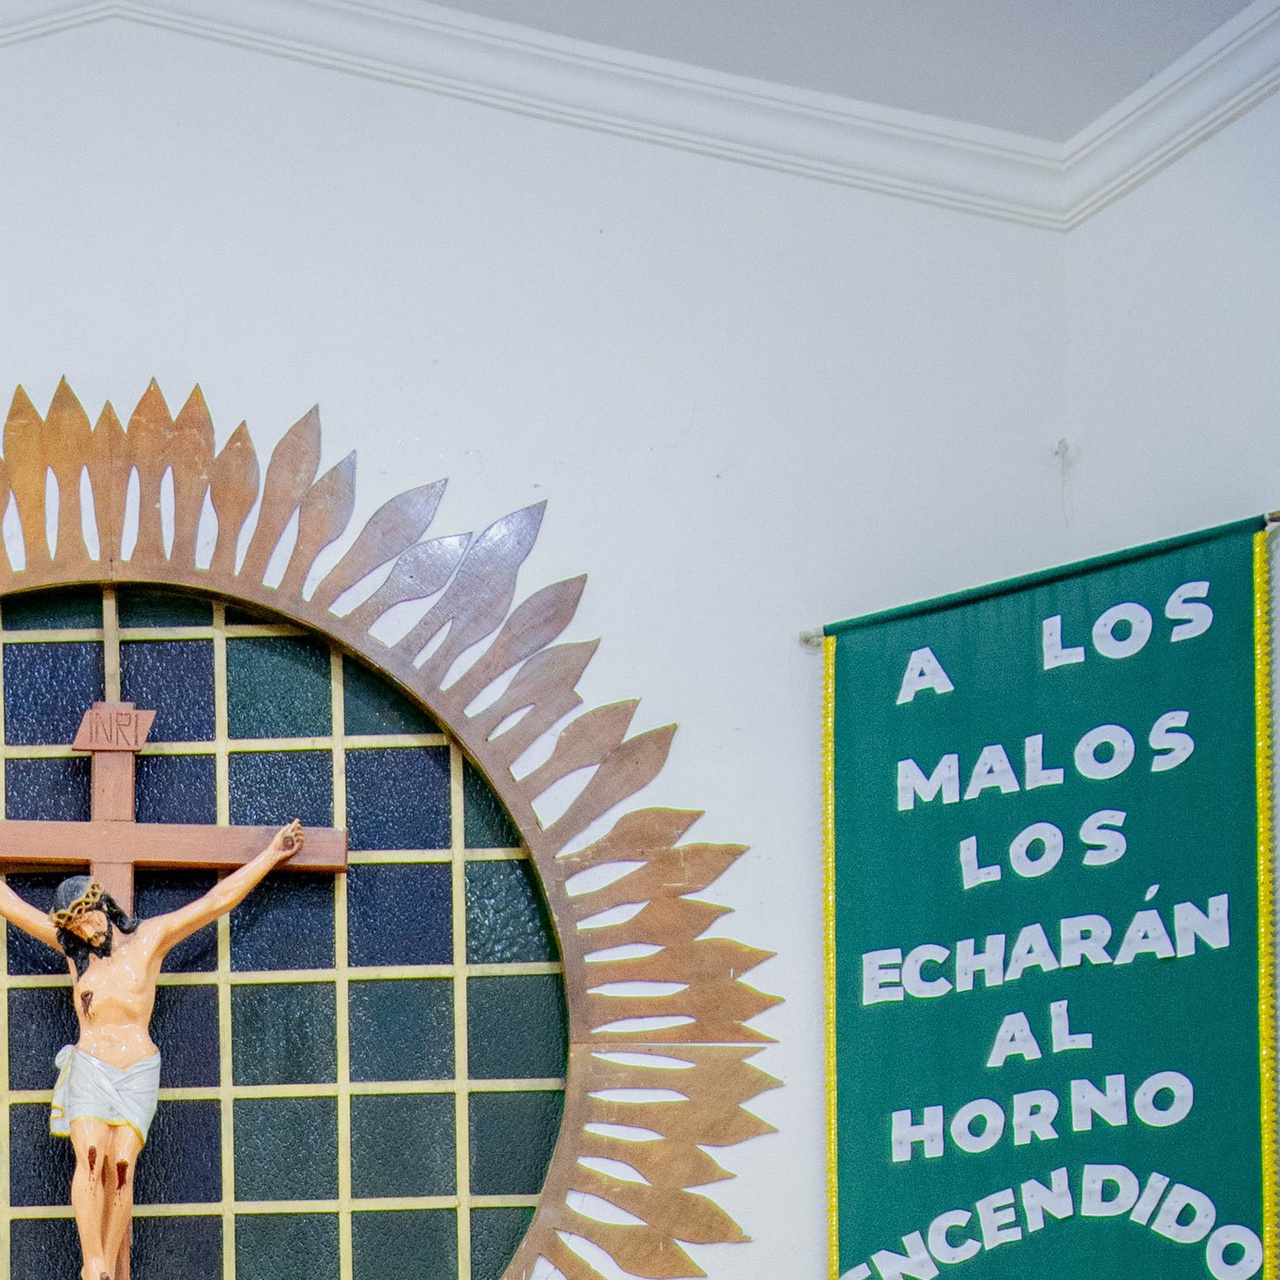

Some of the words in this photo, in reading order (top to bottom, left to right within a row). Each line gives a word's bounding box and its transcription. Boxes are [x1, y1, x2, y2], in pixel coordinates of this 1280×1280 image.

[895, 647, 955, 705] A
[1042, 580, 1214, 671] LOS
[87, 711, 140, 747] INRI
[897, 710, 1195, 812] MALOS
[960, 810, 1127, 890] LOS
[862, 884, 1230, 1006] ECHARÁN
[987, 1000, 1093, 1067] AL
[891, 1071, 1194, 1162] HORNO
